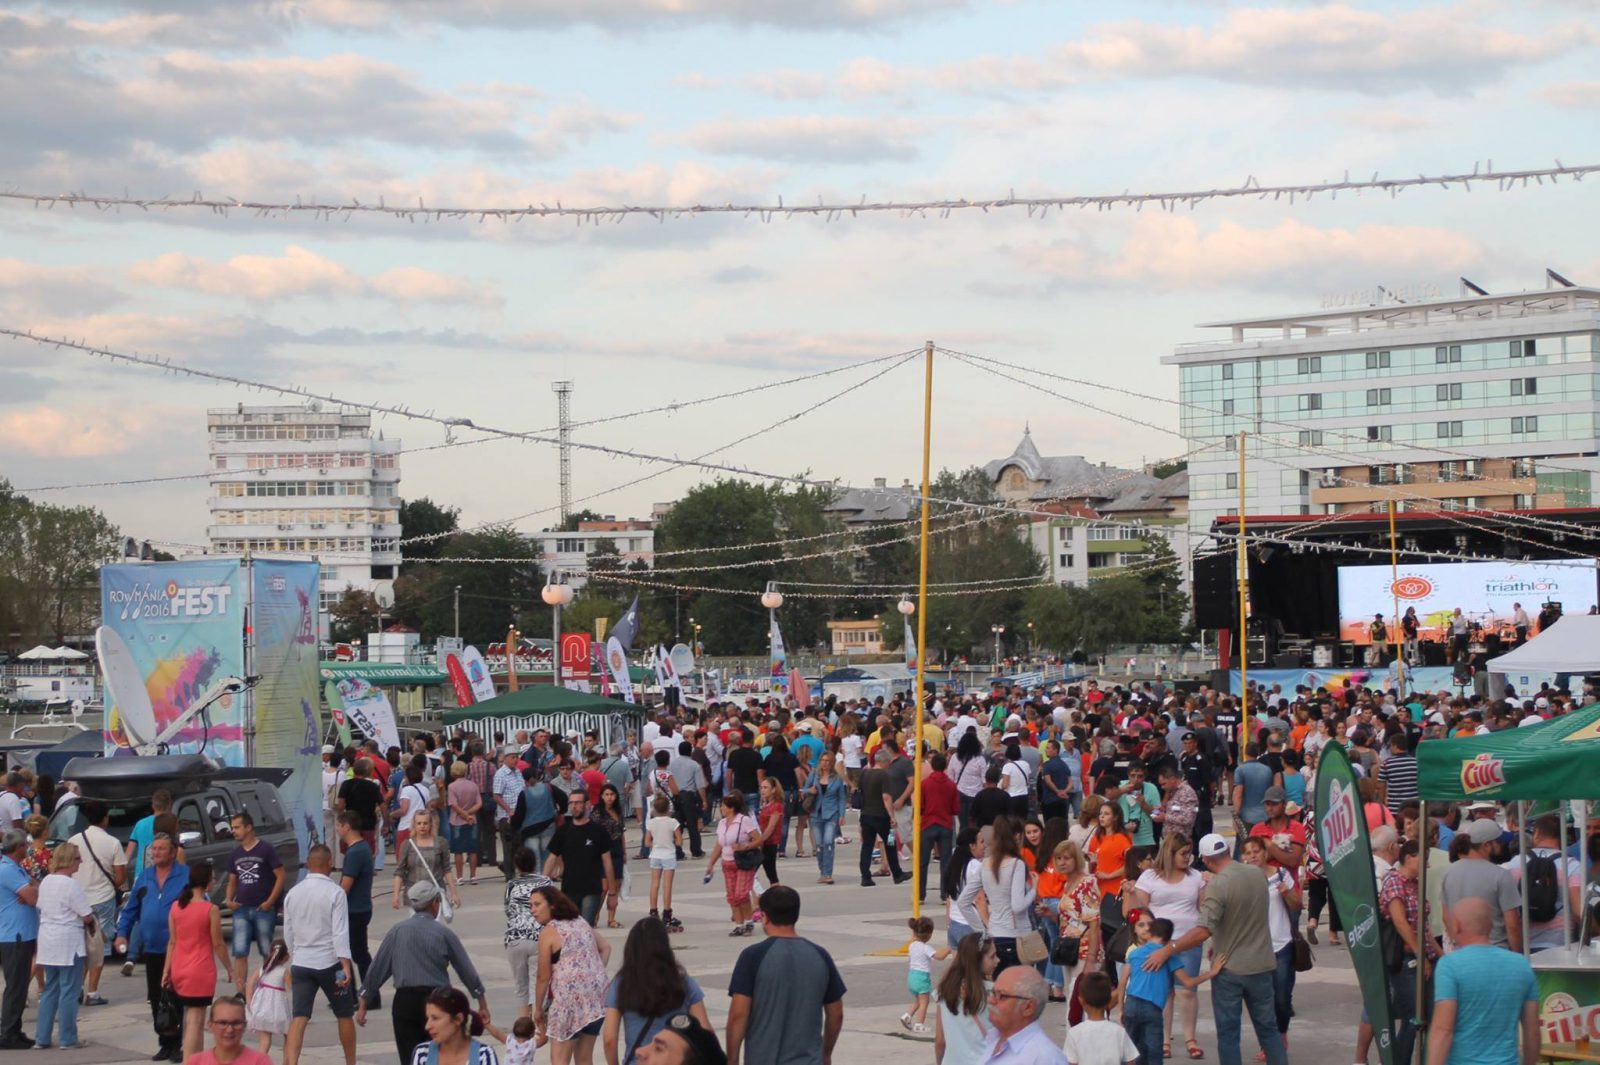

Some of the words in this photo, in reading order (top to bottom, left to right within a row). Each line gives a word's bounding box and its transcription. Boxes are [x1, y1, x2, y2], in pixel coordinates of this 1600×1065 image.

[1320, 288, 1378, 308] HOTEL
[1486, 582, 1558, 592] triathlon
[171, 586, 231, 616] FEST
[144, 604, 170, 617] 2016
